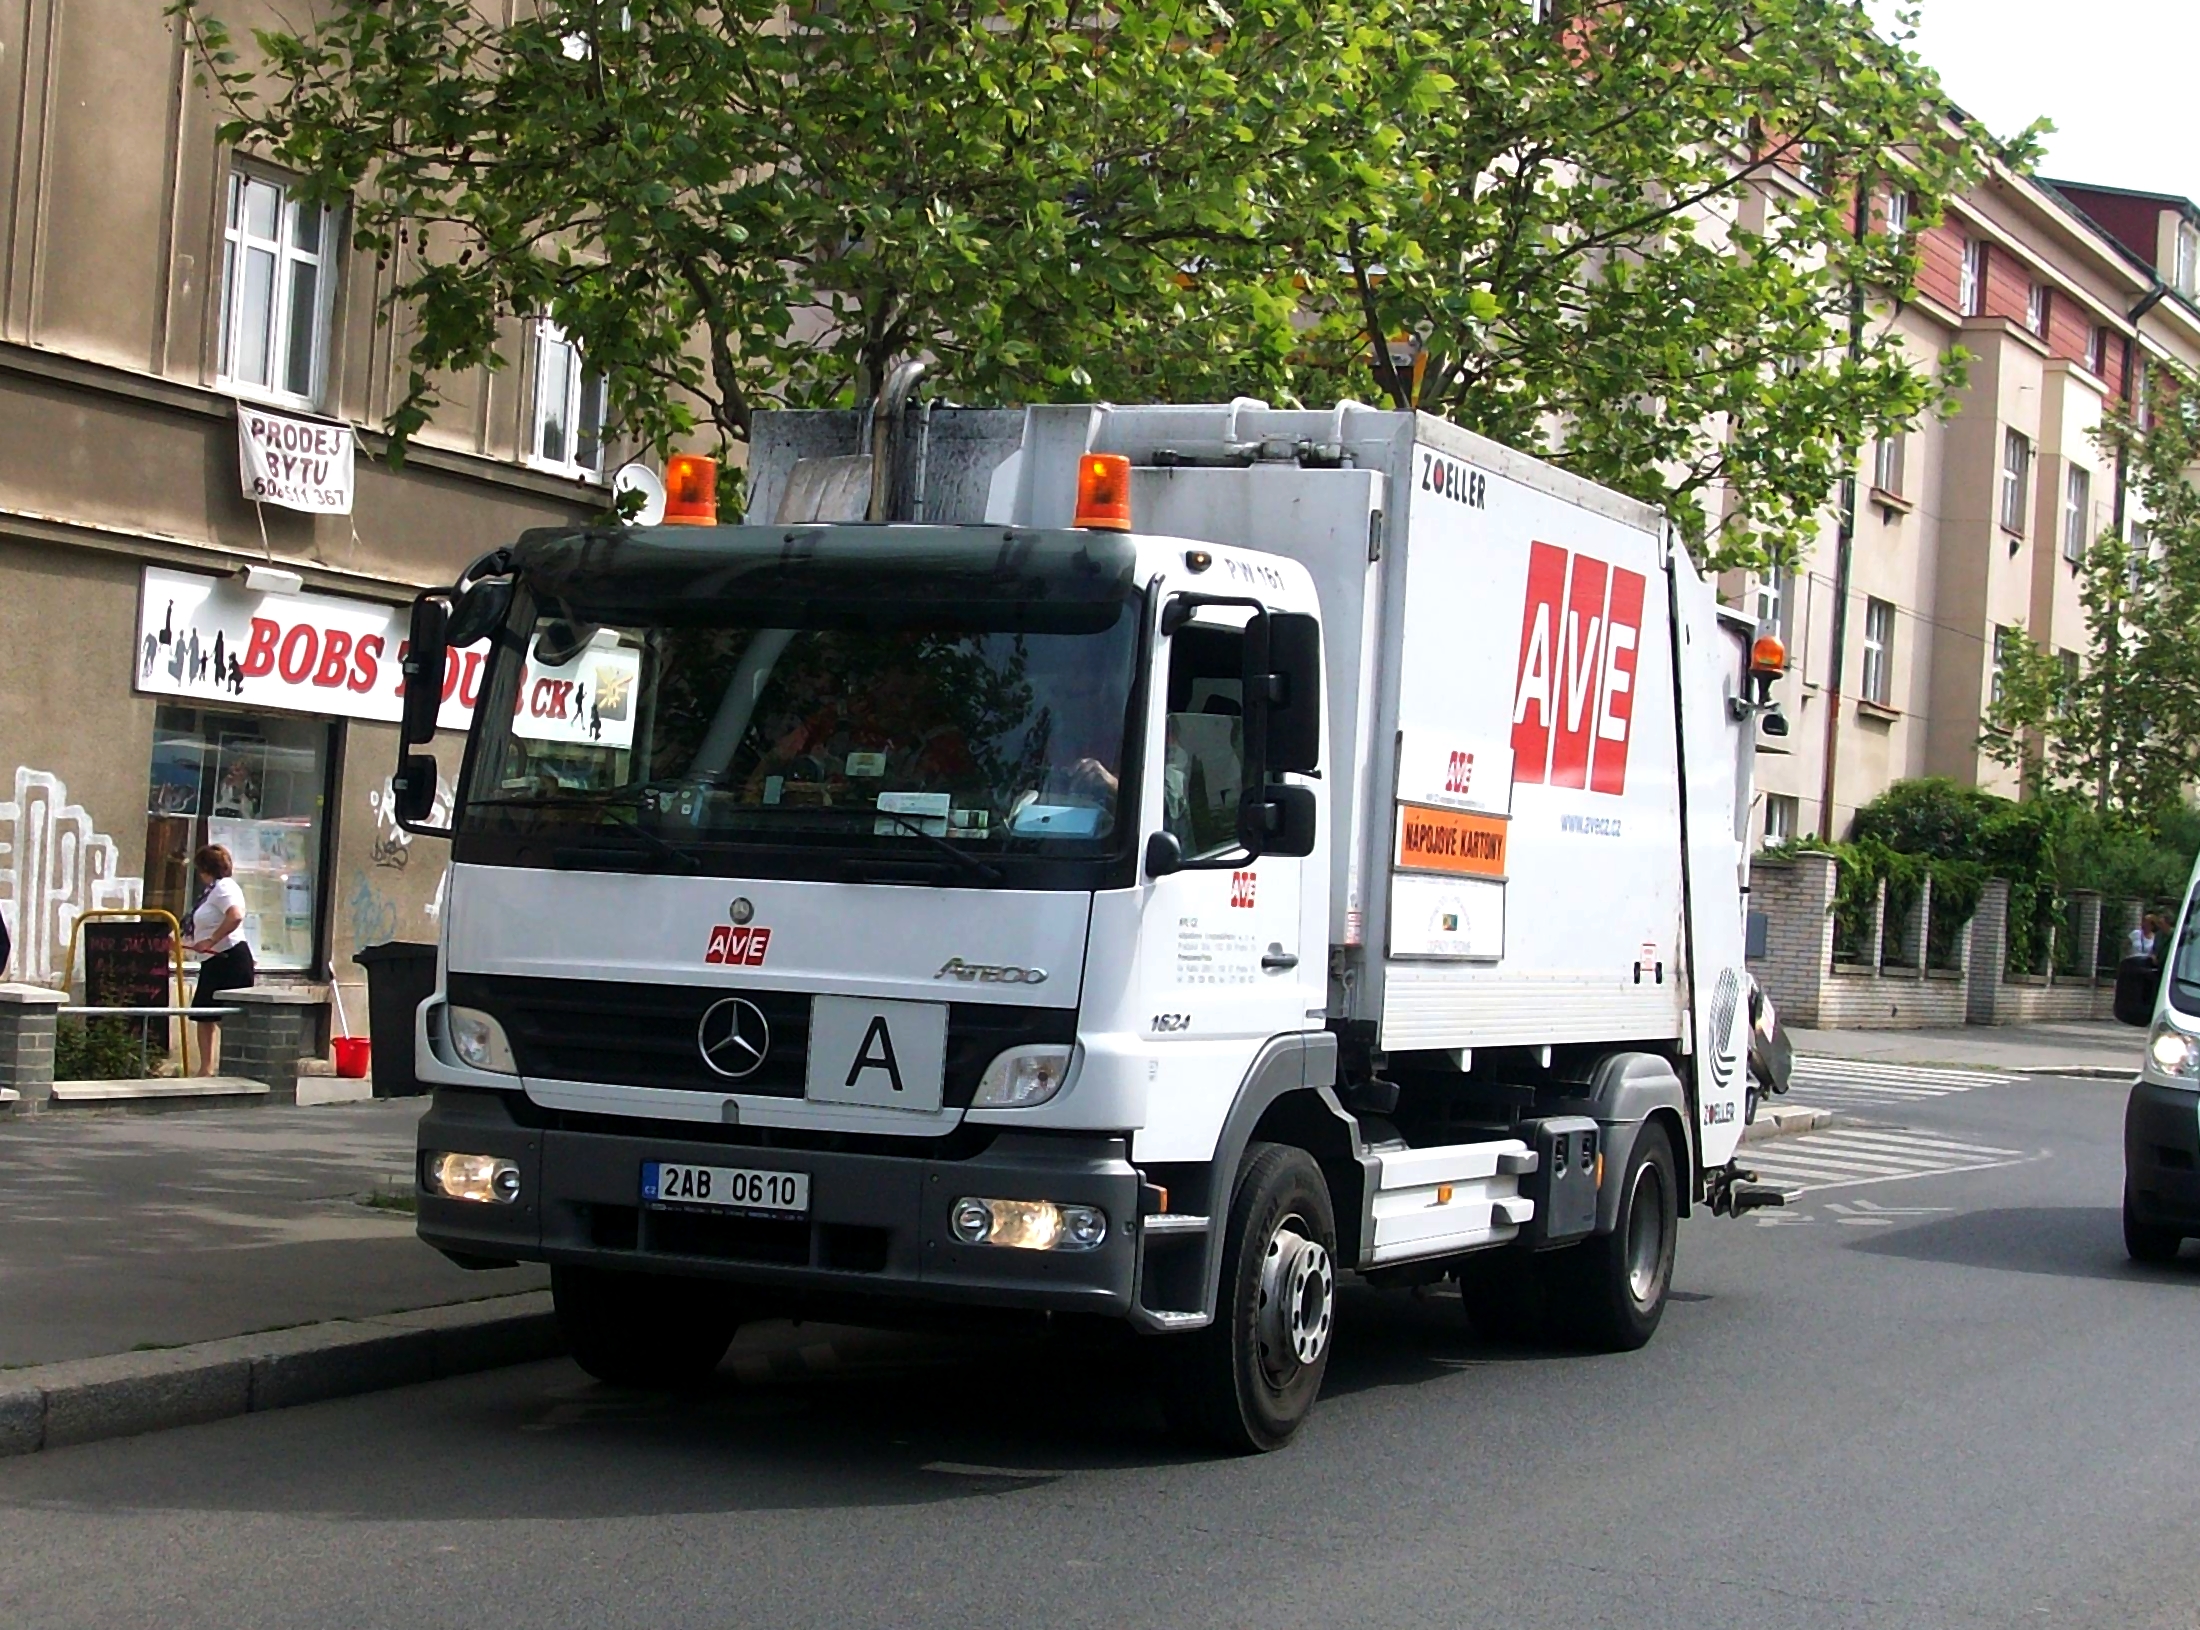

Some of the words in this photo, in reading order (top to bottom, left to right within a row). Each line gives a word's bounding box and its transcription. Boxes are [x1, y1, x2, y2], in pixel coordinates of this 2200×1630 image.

[250, 417, 342, 456] PRODEJ
[265, 451, 329, 486] BYTU
[1421, 452, 1486, 510] ZOELLER
[313, 488, 344, 506] 367
[1256, 565, 1285, 591] 161
[241, 617, 386, 695] BOBS
[530, 677, 575, 720] CK
[1511, 598, 1640, 744] AVE
[1446, 756, 1474, 789] AVE
[1404, 815, 1458, 857] NÁPOJOVÉ
[1459, 828, 1504, 861] KARTONY
[1230, 876, 1257, 902] AVE
[707, 931, 770, 960] AVE
[1150, 1013, 1191, 1033] 1624
[844, 1015, 904, 1092] A
[644, 1185, 657, 1196] CZ
[664, 1167, 712, 1199] 2AB
[732, 1173, 796, 1206] 0610
